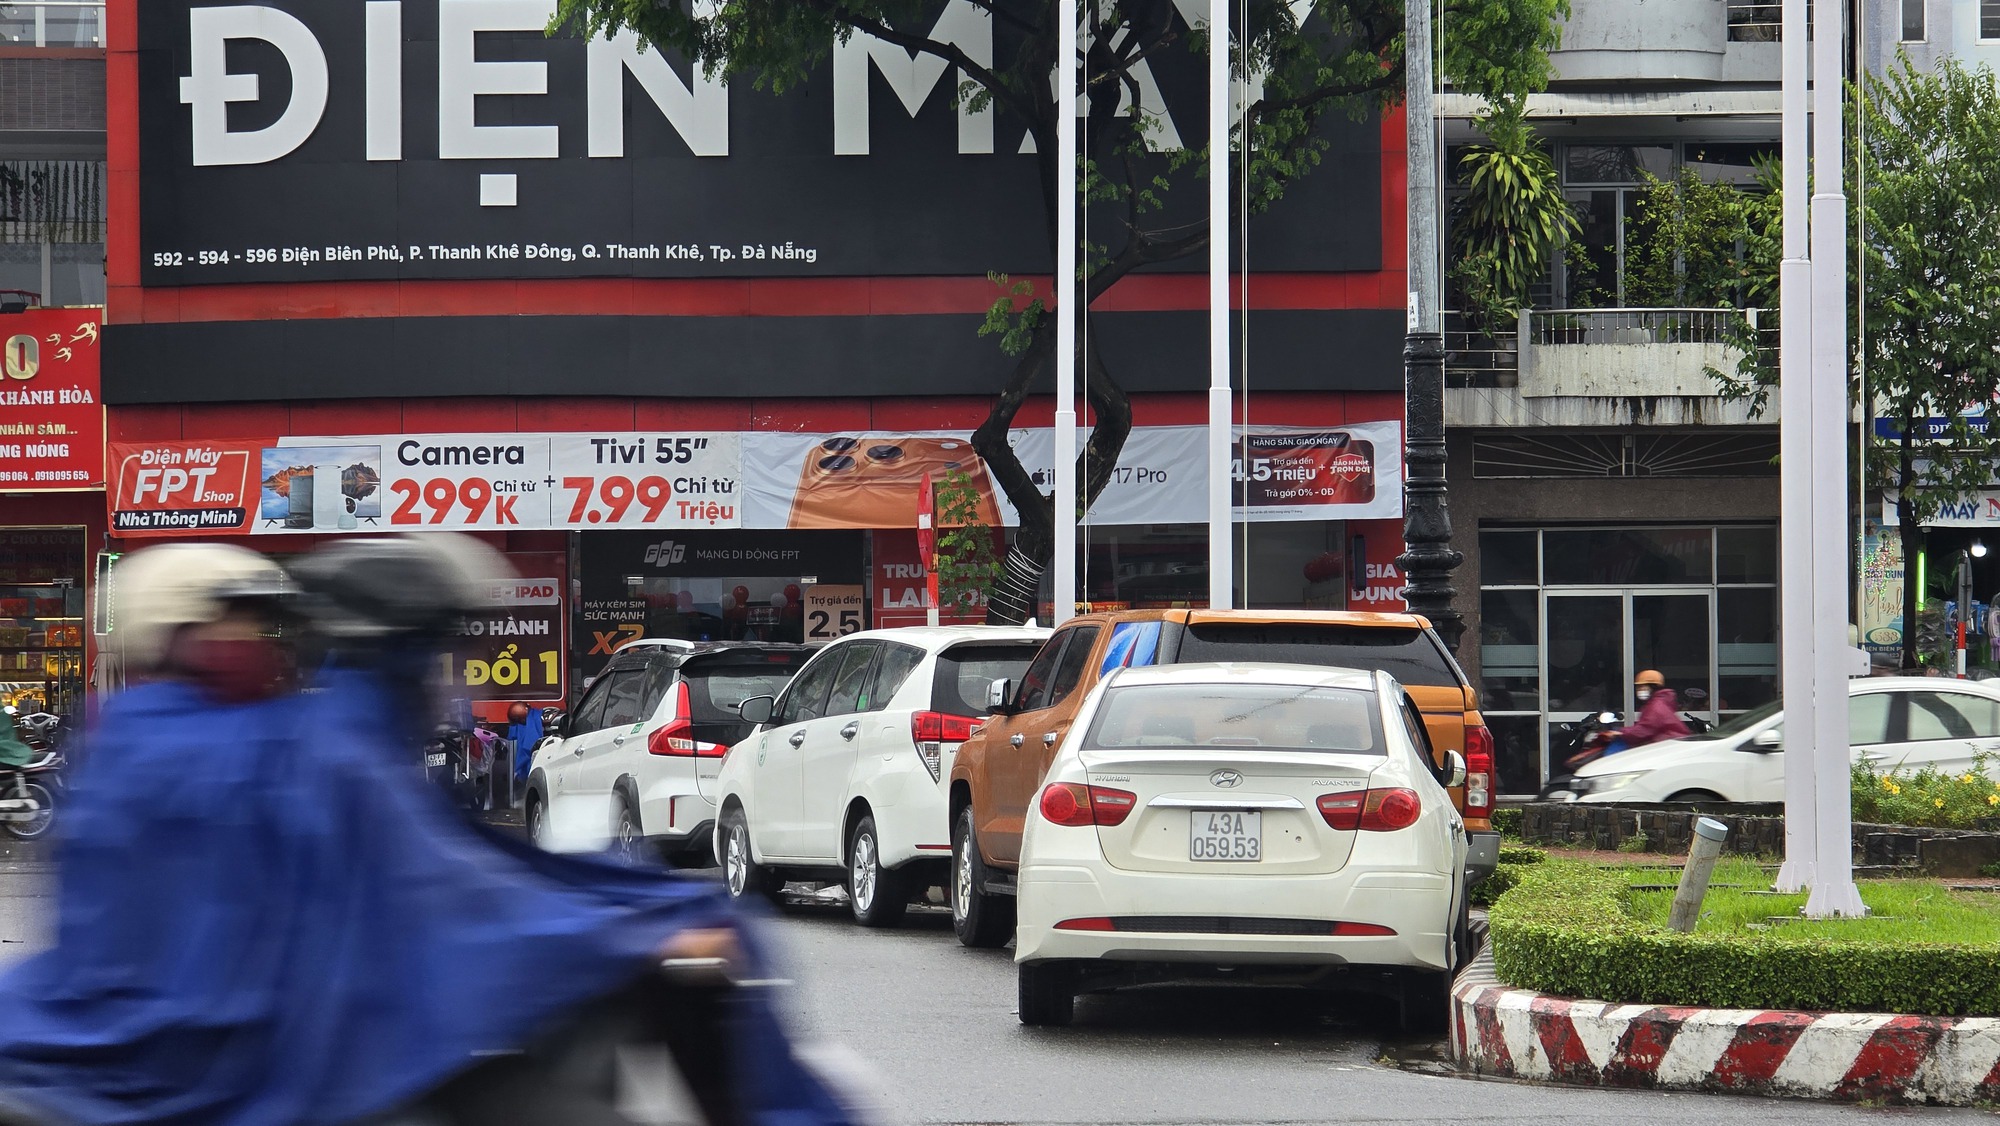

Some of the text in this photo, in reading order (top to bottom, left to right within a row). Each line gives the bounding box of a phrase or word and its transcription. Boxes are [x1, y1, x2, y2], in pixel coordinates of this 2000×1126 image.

[153, 252, 183, 266] 592
[199, 250, 229, 265] 594
[246, 249, 277, 263] 596
[282, 248, 319, 266] Điện
[325, 246, 362, 261] Biên
[367, 244, 404, 263] Phủ,
[410, 246, 423, 260] P.
[428, 245, 483, 260] Thanh
[486, 244, 519, 259] Khê
[525, 243, 577, 261] Đông,
[581, 244, 601, 259] Q.
[606, 244, 659, 259] Thanh
[665, 244, 704, 262] Khê,
[710, 245, 736, 263] Tp.
[741, 244, 766, 260] Đà
[771, 241, 817, 263] Nẵng
[0, 334, 39, 380] O
[59, 384, 94, 404] HÒA
[26, 439, 69, 458] NÓNG
[590, 437, 645, 465] Tivi
[1253, 438, 1276, 446] HÀNG
[1317, 437, 1338, 445] NGAY
[140, 448, 222, 469] Điện Máy
[397, 440, 525, 466] Camera
[1273, 458, 1285, 466] Trợ
[1286, 458, 1298, 466] giá
[1299, 457, 1314, 465] đến
[1113, 467, 1167, 484] 17 Pro
[1274, 466, 1316, 483] TRIỆU
[133, 467, 234, 504] FPT Shop
[493, 479, 536, 494] Chỉ từ
[673, 477, 734, 494] Chỉ từ
[1265, 489, 1278, 497] Trả
[1279, 489, 1296, 499] góp
[1297, 488, 1313, 497] 0%
[563, 475, 734, 526] 7.99 Triệu
[119, 510, 237, 529] Nhà Thông Minh
[643, 540, 800, 567] FPT MẠNG DI ĐỘNG FPT
[1365, 563, 1398, 578] GIA
[515, 586, 554, 598] IPAD
[809, 594, 861, 606] Trợ giá đến
[584, 599, 606, 609] MÁY
[606, 599, 627, 608] KÈM
[454, 615, 549, 636] ẢO HÀNH
[584, 610, 645, 622] SỨC MẠNH
[809, 610, 861, 637] 2.5
[463, 643, 530, 686] ĐỔI
[538, 650, 558, 684] 1
[1208, 813, 1244, 835] 43A
[1193, 837, 1259, 858] 059.53
